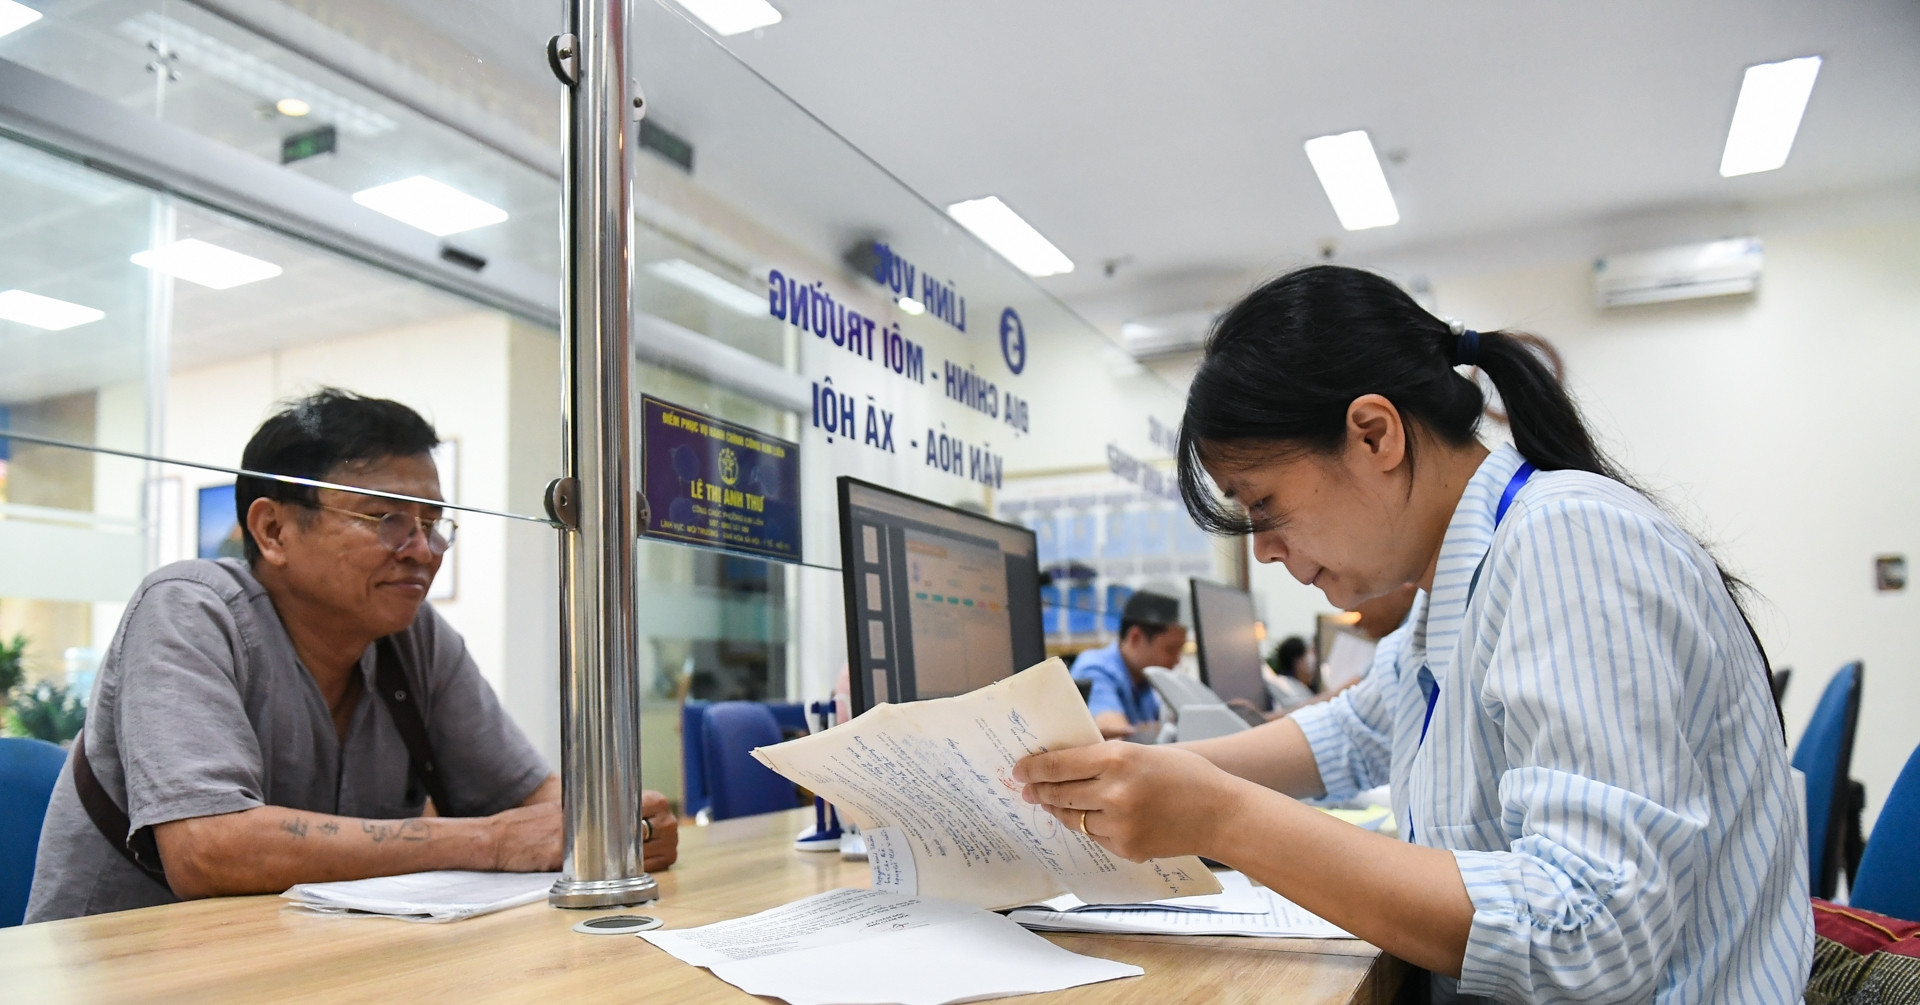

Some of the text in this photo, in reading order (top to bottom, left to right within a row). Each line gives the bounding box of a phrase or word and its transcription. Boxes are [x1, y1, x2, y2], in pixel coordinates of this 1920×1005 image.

[690, 478, 703, 499] LÊ
[706, 484, 722, 506] THỊ
[746, 493, 765, 512] THƯ
